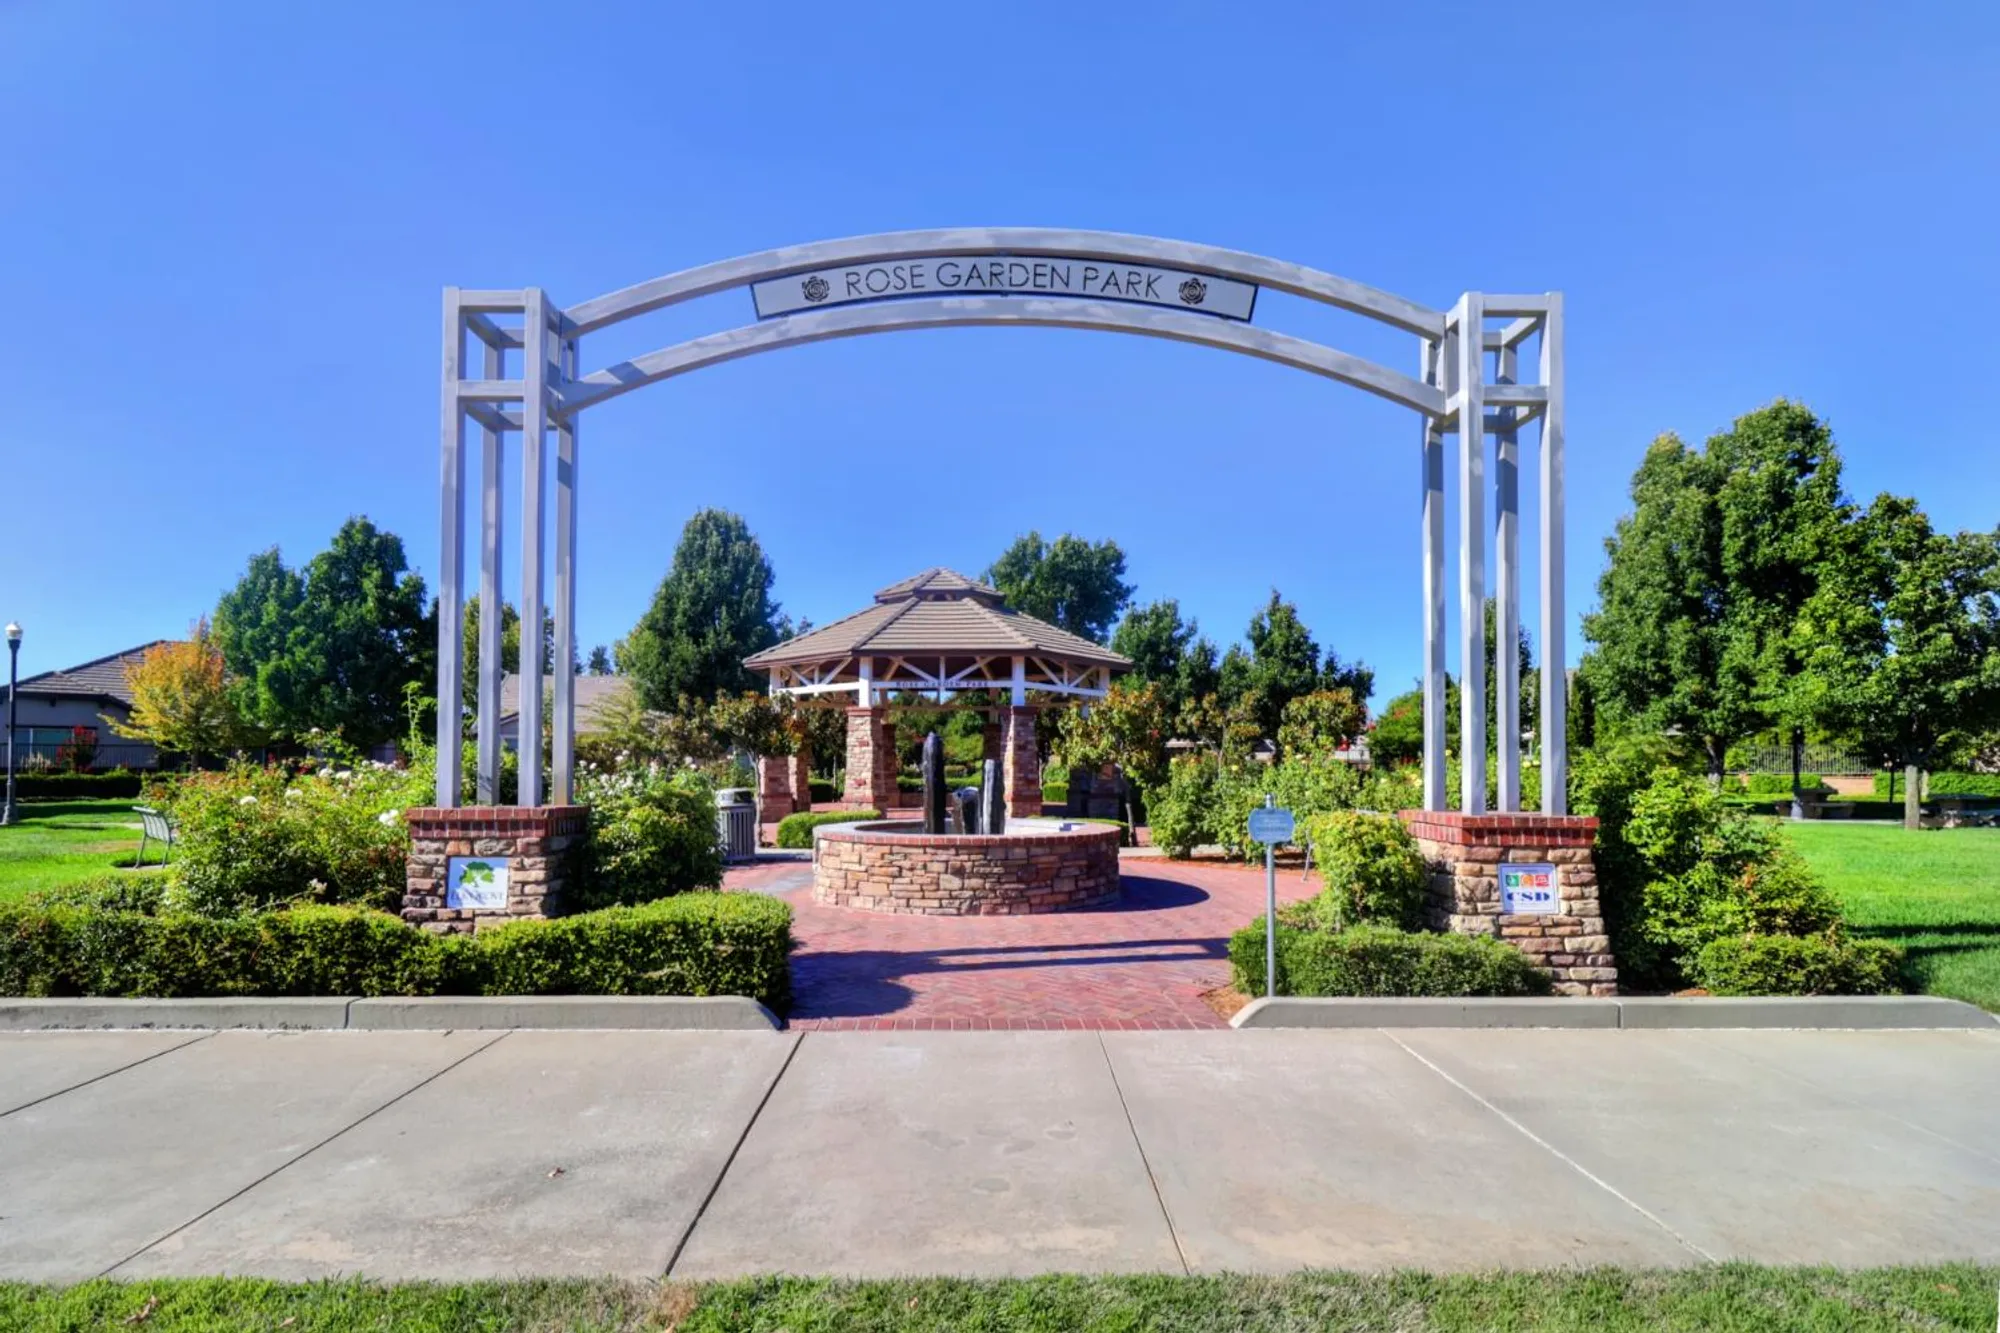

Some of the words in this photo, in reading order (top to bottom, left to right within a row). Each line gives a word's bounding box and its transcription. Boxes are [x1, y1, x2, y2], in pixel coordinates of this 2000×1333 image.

[845, 265, 926, 297] ROSE
[936, 262, 1071, 289] GARDEN
[1083, 266, 1163, 299] PARK
[1506, 892, 1550, 901] CSD
